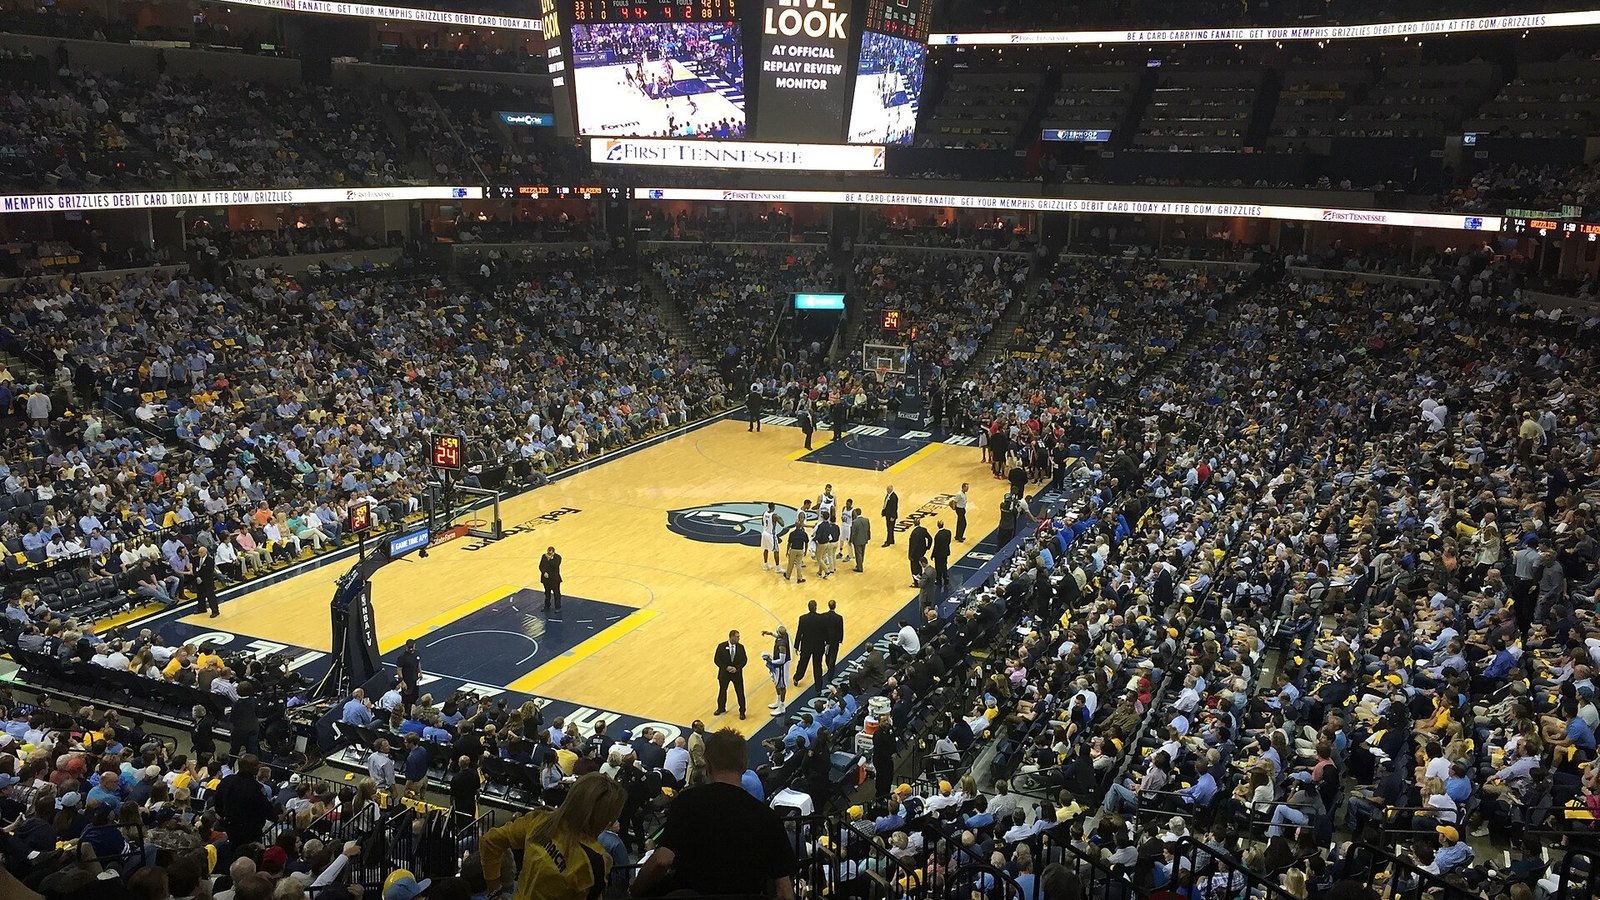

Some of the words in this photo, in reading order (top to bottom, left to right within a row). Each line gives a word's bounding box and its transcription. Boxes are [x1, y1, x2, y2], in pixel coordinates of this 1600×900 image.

[337, 4, 351, 13] GET
[354, 6, 375, 15] YOUR
[378, 8, 413, 19] MEMPHIS
[415, 11, 453, 22] GRIZZLIES
[455, 14, 475, 24] DEBIT
[478, 16, 497, 26] CARD
[499, 18, 520, 28] TODAY
[523, 20, 531, 28] AT
[533, 20, 542, 29] FT
[621, 7, 628, 19] 4
[635, 7, 642, 18] 4
[664, 7, 671, 18] 4
[685, 6, 692, 18] 2
[701, 9, 712, 18] 88
[541, 11, 561, 40] LOOK
[765, 8, 848, 39] LOOK
[1127, 32, 1136, 41] BE
[1138, 32, 1144, 40] A
[1210, 30, 1244, 39] FANATIC
[1249, 30, 1264, 38] GET
[1267, 29, 1288, 38] YOUR
[1291, 28, 1329, 37] MEMPHIS
[1332, 26, 1371, 36] GRIZZLIES
[1373, 25, 1395, 34] DEBIT
[1397, 24, 1418, 33] CARD
[1420, 22, 1445, 32] TODAY
[1448, 21, 1458, 30] AT
[772, 45, 787, 55] AT
[788, 45, 835, 58] OFFICIAL
[763, 61, 802, 73] REPLAY
[803, 63, 842, 75] REVIEW
[776, 77, 828, 90] MONITOR
[624, 144, 669, 160] FIRST
[671, 144, 803, 164] TENNESSEE
[5, 196, 54, 210] MEMPHIS
[58, 195, 109, 208] GRIZZLIES
[113, 194, 140, 206] DEBIT
[144, 194, 168, 205] CARD
[171, 193, 198, 205] TODAY
[202, 192, 211, 204] AT
[750, 192, 786, 200] TENNESSEE
[845, 194, 853, 202] BE
[857, 194, 862, 202] A
[865, 194, 923, 204] CARD-CARRYING
[925, 196, 956, 206] FANATIC
[960, 198, 974, 206] GET
[978, 198, 997, 207] YOUR
[1000, 199, 1035, 208] MEMPHIS
[1038, 200, 1078, 210] GRIZZLIES
[1081, 201, 1103, 211] DEBIT
[1107, 202, 1129, 211] CARD
[1132, 203, 1158, 212] TODAY
[1161, 203, 1171, 212] AT
[1332, 212, 1349, 221] FIRST
[1349, 212, 1387, 223] TENNESSEE
[1530, 220, 1557, 230] GRIZZLIES
[884, 317, 897, 328] 24
[442, 438, 458, 448] 1:59
[437, 447, 456, 465] 24
[354, 515, 366, 527] 24
[395, 541, 408, 550] GAME
[408, 536, 418, 546] TIME
[418, 532, 428, 542] APP
[361, 606, 370, 630] NBA
[365, 631, 372, 647] TV
